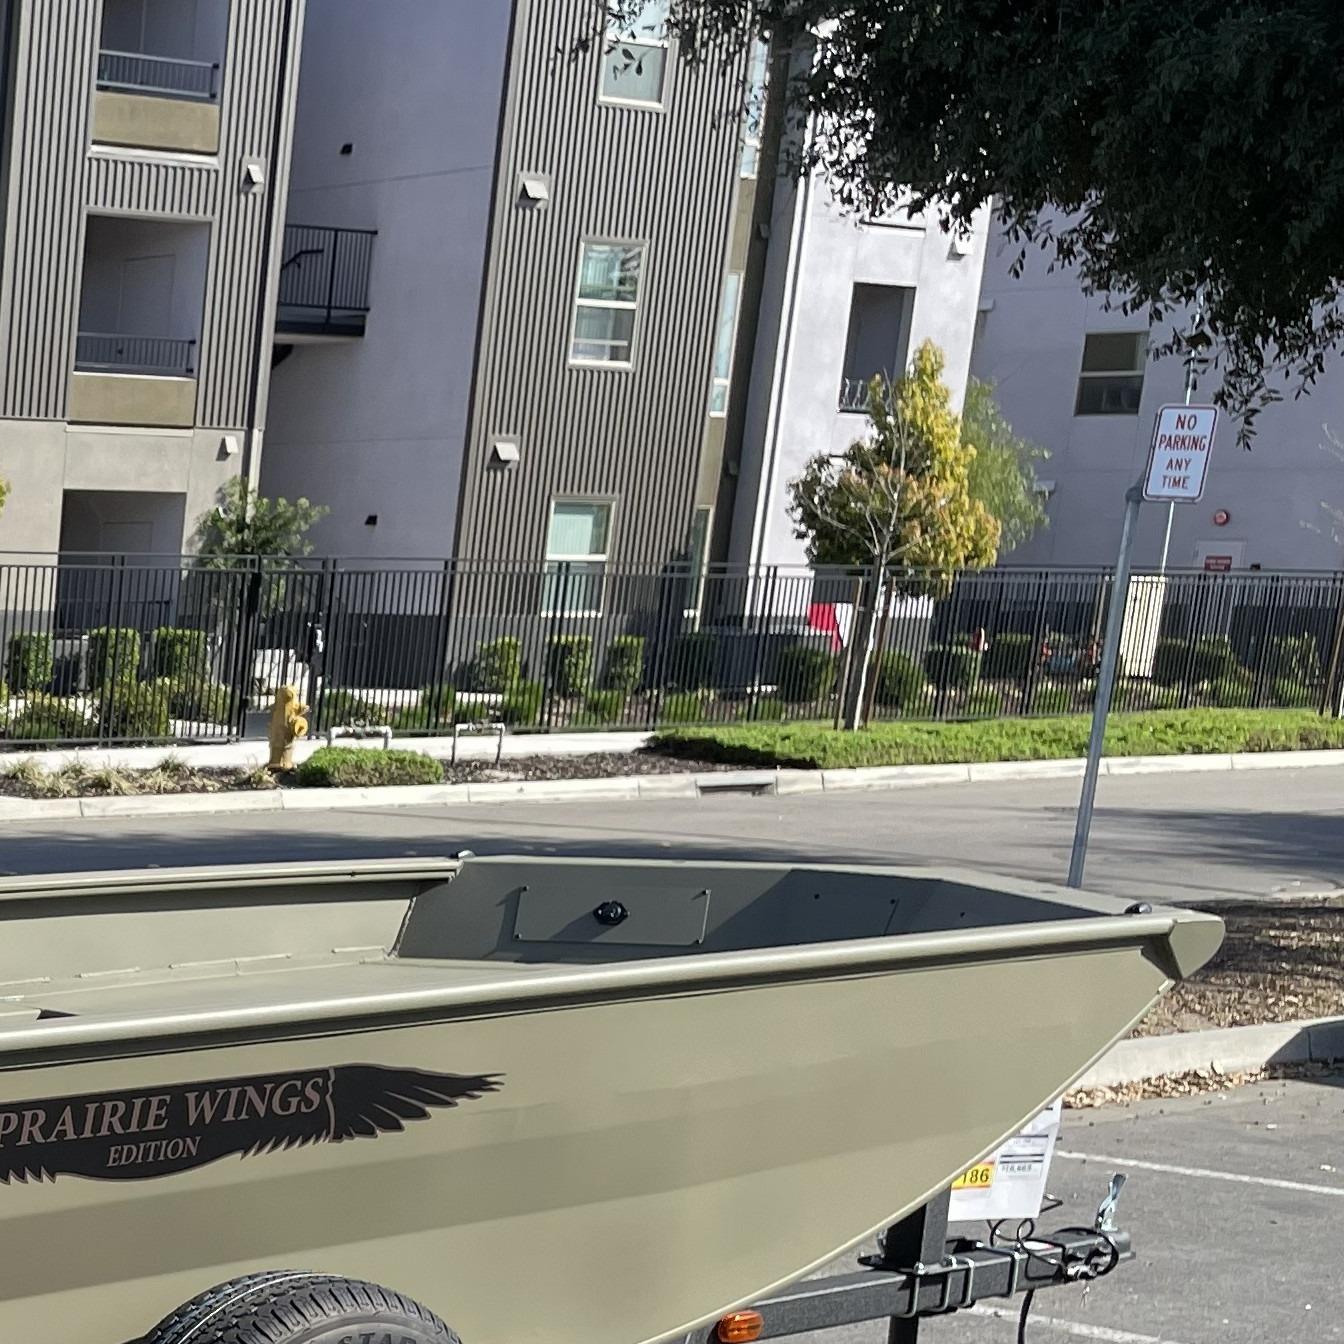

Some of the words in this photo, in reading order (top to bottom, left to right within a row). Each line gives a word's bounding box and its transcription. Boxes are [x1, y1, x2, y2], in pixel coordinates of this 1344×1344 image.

[1175, 413, 1197, 431] NO
[1158, 434, 1207, 451] PARKING
[1166, 457, 1192, 471] ANY
[1162, 475, 1190, 489] TIME
[183, 1077, 323, 1127] WINGS
[107, 1136, 201, 1168] EDITION
